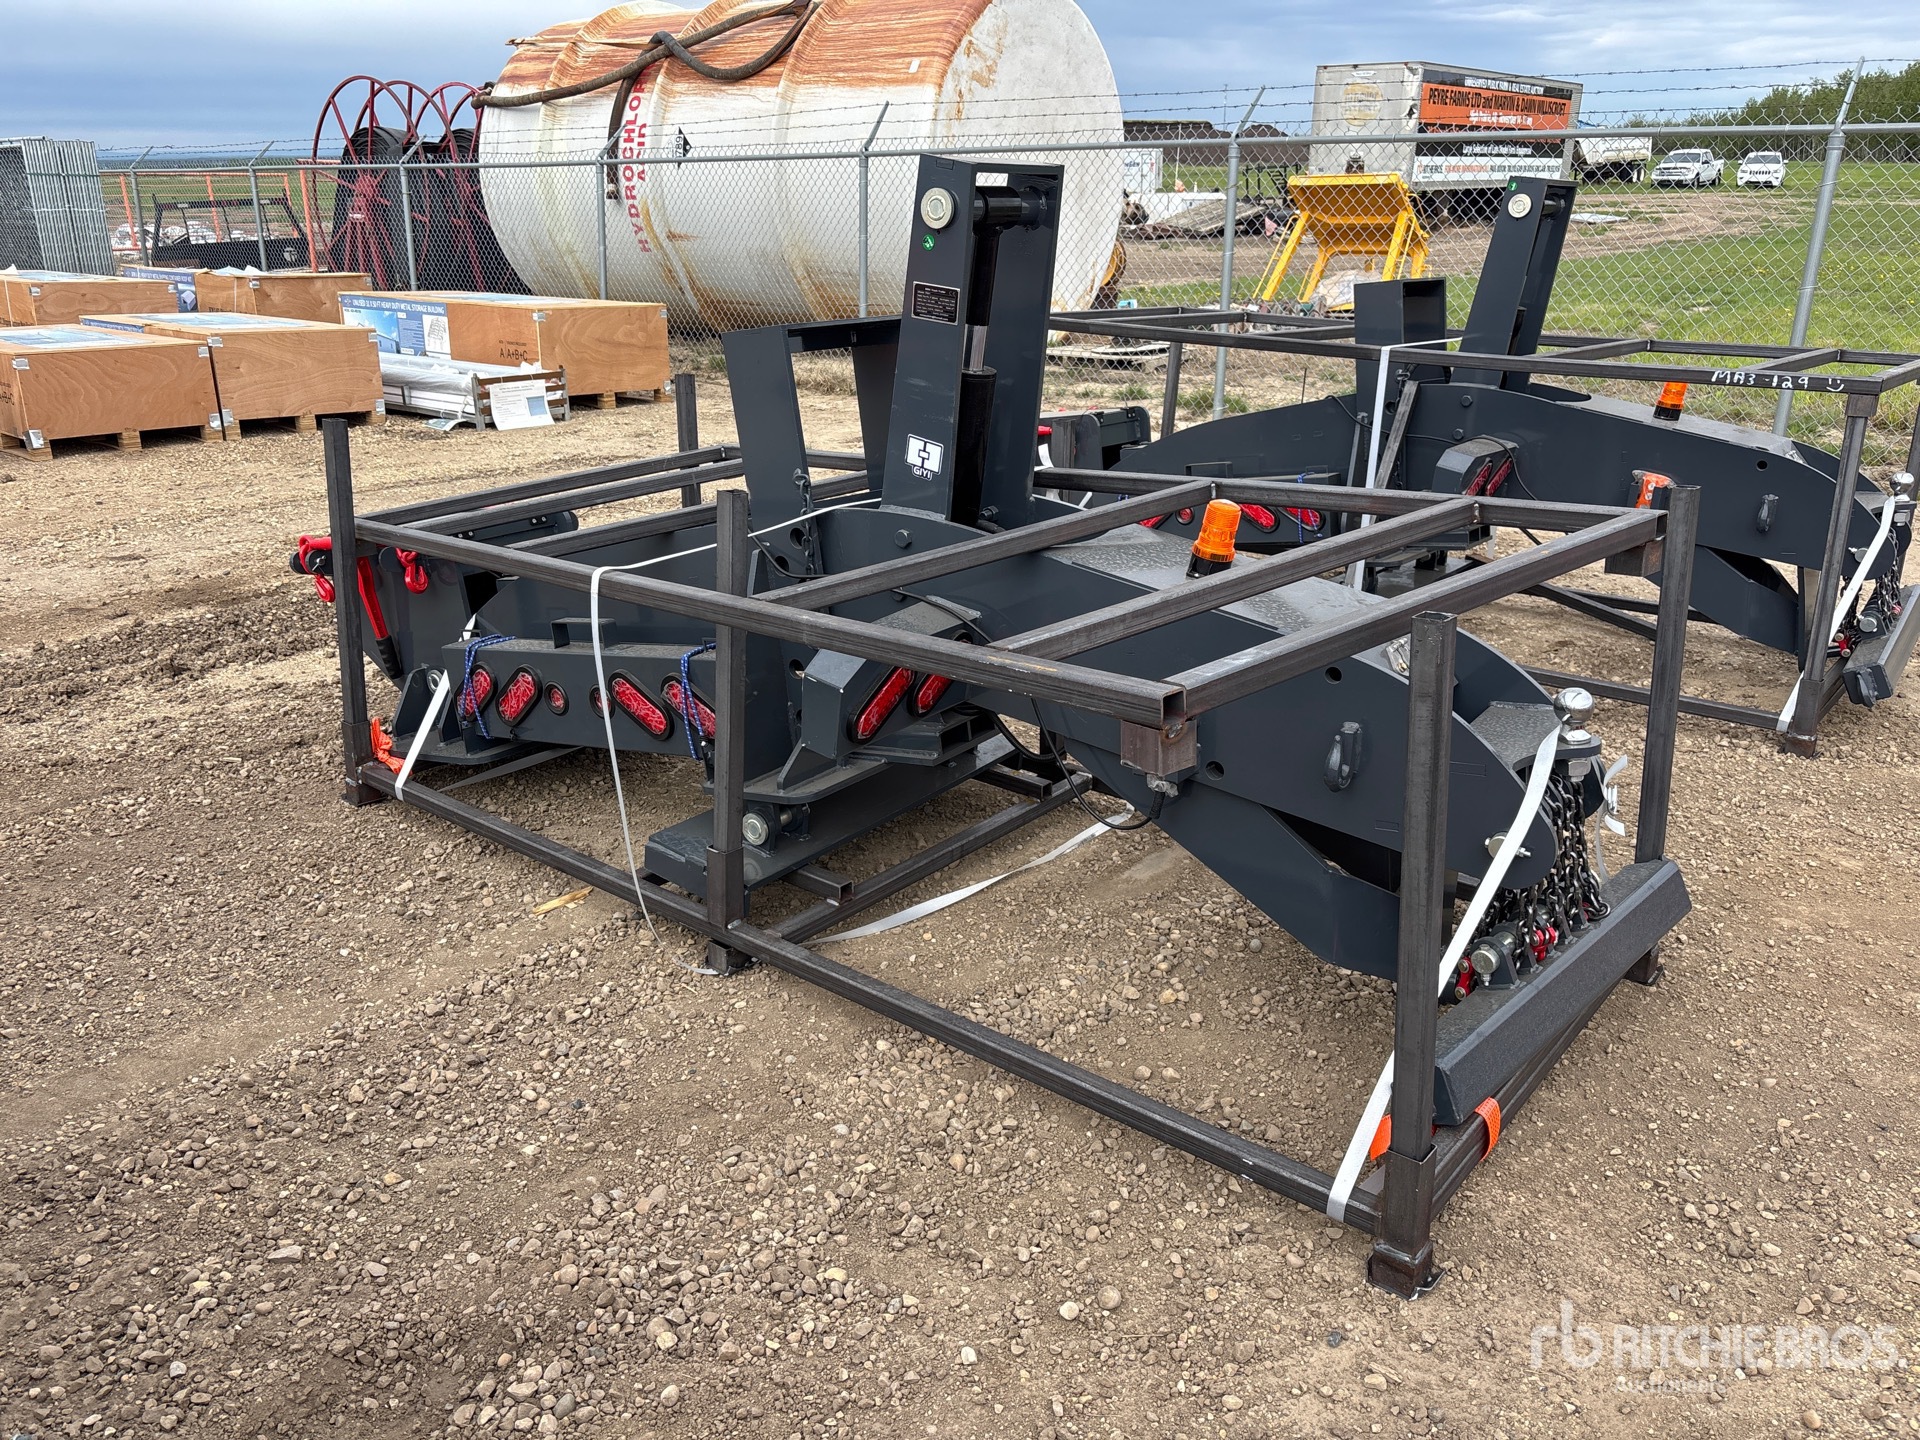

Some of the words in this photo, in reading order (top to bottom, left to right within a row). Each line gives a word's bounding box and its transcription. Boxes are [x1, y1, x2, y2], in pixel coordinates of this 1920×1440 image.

[1428, 88, 1449, 105] PEYRE
[1449, 90, 1470, 107] FARMS
[1470, 91, 1481, 108] LTD
[1482, 93, 1493, 109] and
[1494, 94, 1516, 111] MARVIN
[1516, 97, 1520, 112] &
[1521, 98, 1536, 113] DAWN
[913, 466, 930, 479] GIYI
